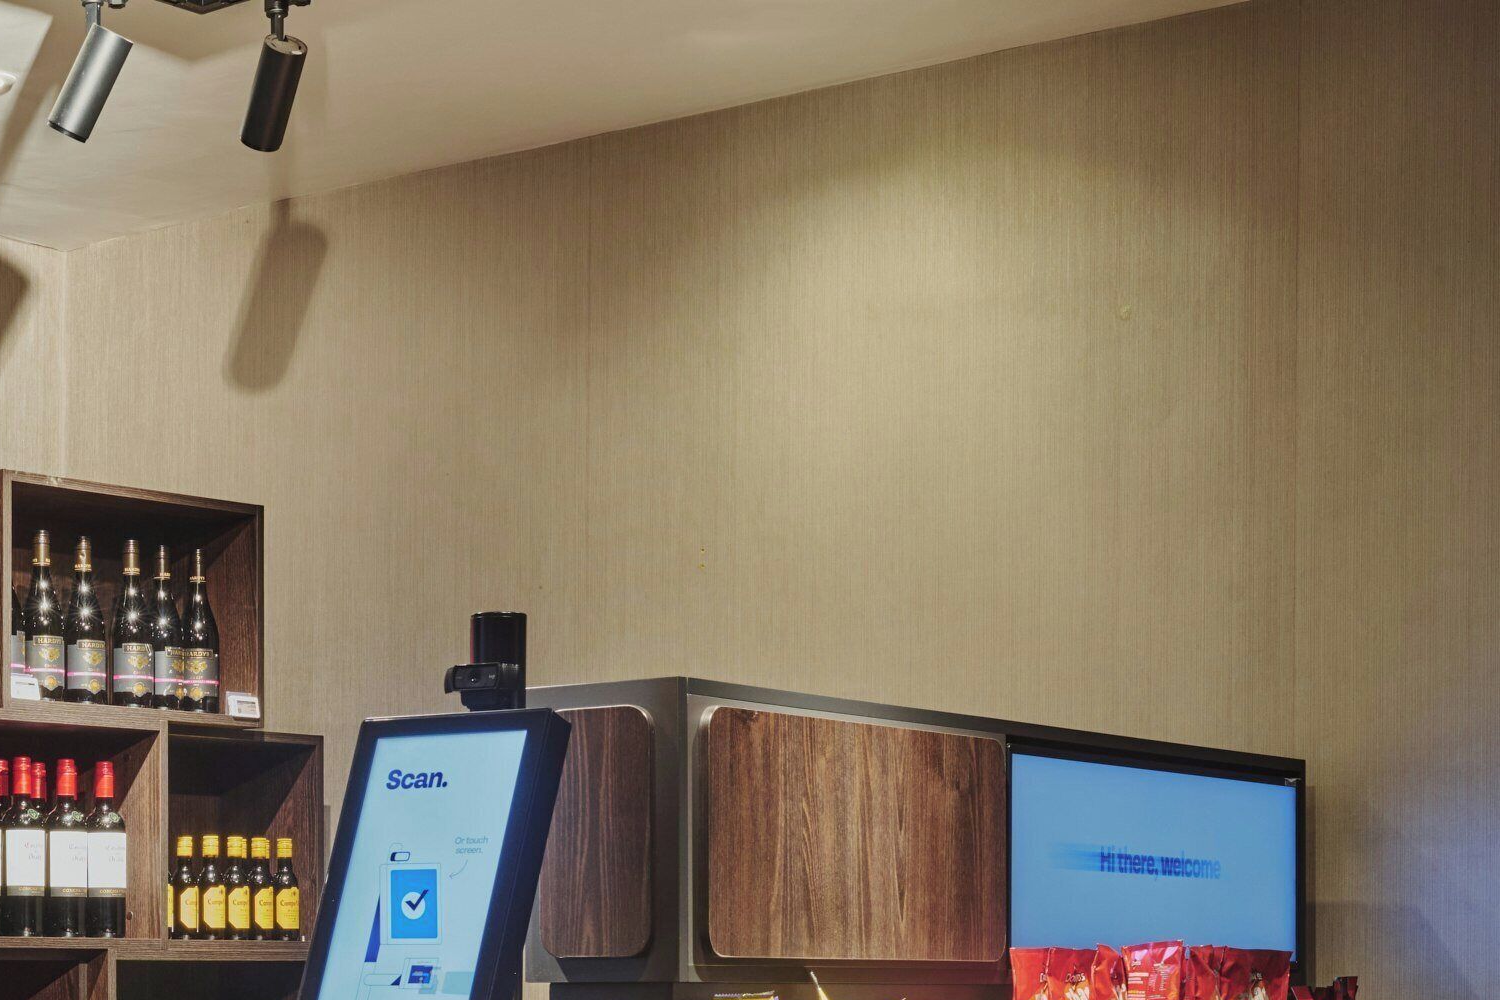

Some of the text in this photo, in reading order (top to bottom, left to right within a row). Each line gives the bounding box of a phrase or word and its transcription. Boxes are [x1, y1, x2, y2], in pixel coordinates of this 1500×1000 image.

[386, 769, 449, 790] Scan.
[454, 835, 489, 845] Or touch
[455, 846, 484, 855] screen.
[1100, 846, 1221, 880] Hi there, welcome
